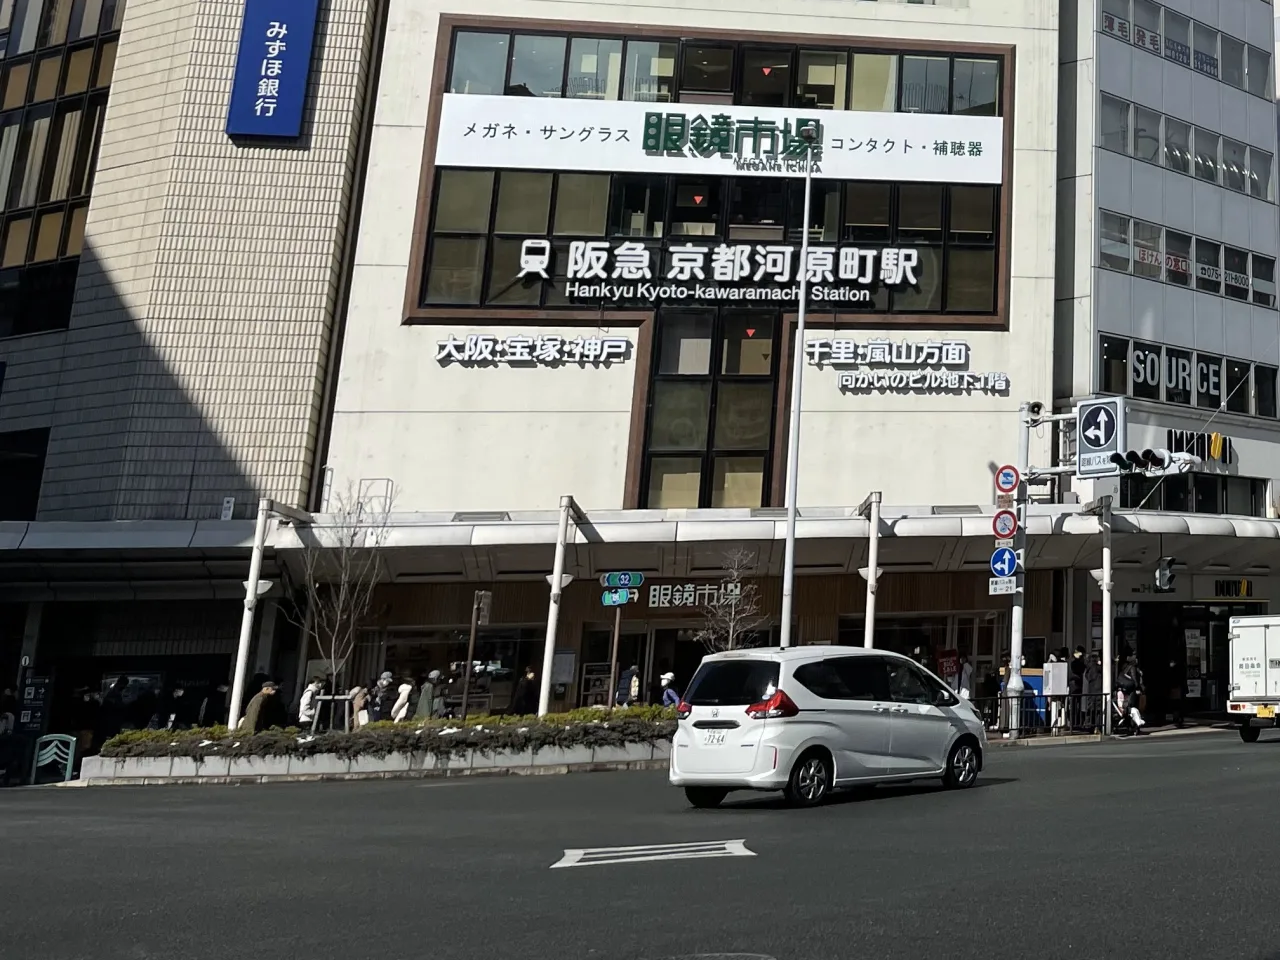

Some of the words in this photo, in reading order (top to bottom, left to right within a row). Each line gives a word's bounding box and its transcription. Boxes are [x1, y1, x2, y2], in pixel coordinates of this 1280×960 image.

[1104, 14, 1129, 39] 薄毛
[1136, 27, 1160, 52] 発毛
[255, 21, 288, 117] みずほ銀行
[463, 122, 630, 142] メガネ・サングラス
[642, 111, 825, 159] 眼鏡市場
[831, 137, 983, 157] コンタクト・補聴器
[566, 241, 652, 280] 阪急
[667, 242, 918, 285] 京都河原町駅
[1139, 248, 1188, 273] ほけんの窓口
[565, 282, 633, 301] Hankyu
[637, 283, 803, 302] Kyoto-kawaramach
[811, 286, 870, 301] Station
[435, 333, 629, 362] 大阪・宝塚・神戸
[805, 338, 967, 365] 千里・嵐山方面
[838, 371, 1008, 390] 向かいのビル地下1階
[1133, 350, 1219, 395] SOURCE
[619, 574, 630, 584] 32
[648, 582, 742, 608] 眼鏡市場
